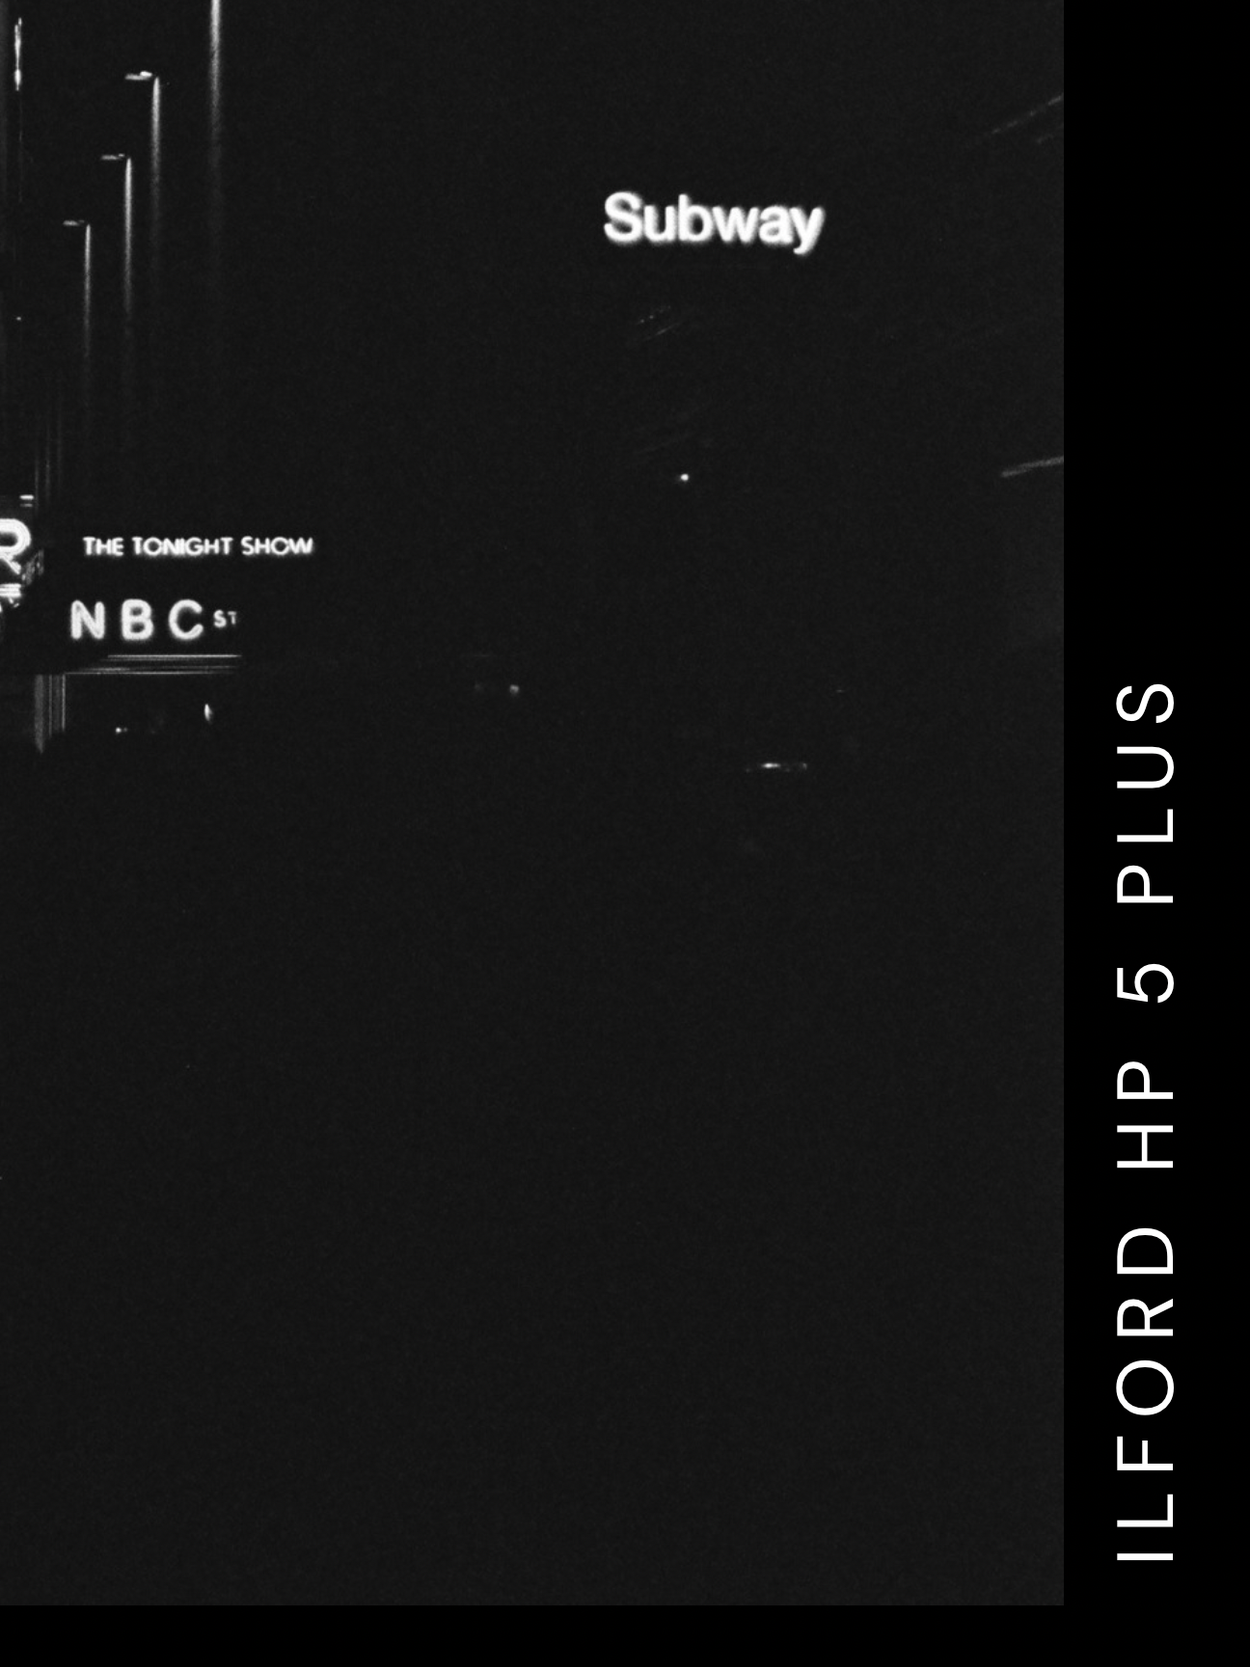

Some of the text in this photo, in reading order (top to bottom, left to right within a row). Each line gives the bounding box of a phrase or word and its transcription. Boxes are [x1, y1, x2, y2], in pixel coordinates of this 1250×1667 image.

[603, 190, 826, 256] Subway
[82, 536, 314, 558] THE TONIGHT SHOW
[70, 598, 204, 642] NBC
